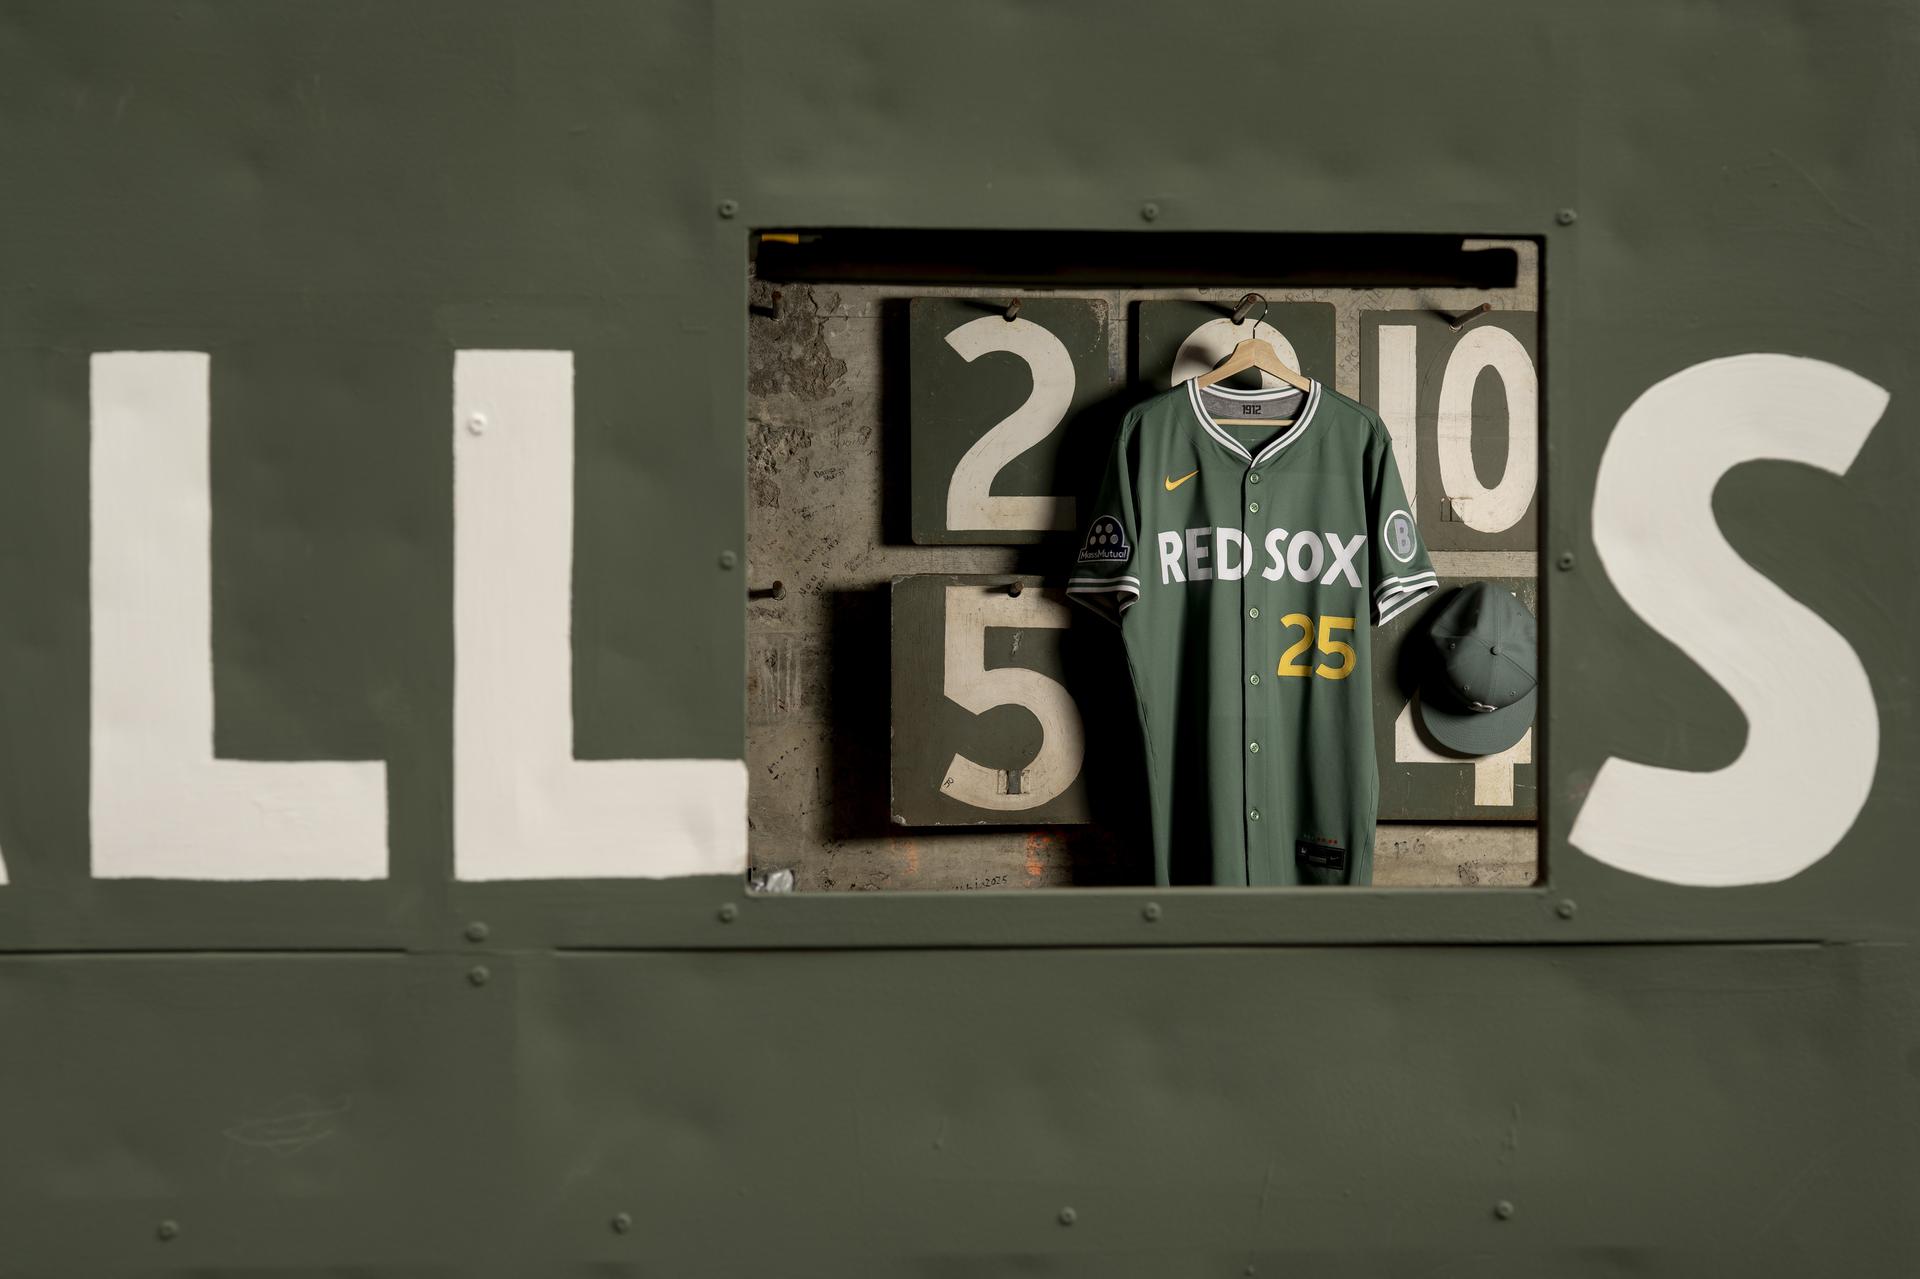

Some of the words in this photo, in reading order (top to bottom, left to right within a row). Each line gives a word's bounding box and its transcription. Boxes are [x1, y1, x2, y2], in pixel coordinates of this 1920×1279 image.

[944, 315, 1076, 531] 2
[1242, 404, 1262, 415] 1912
[1378, 324, 1538, 533] 10
[1080, 549, 1127, 559] MassMutual
[1158, 527, 1253, 585] RED
[1262, 528, 1367, 588] SOX
[1394, 518, 1411, 554] B
[0, 349, 748, 884] LL
[1277, 613, 1357, 680] 25
[940, 586, 1085, 811] 5
